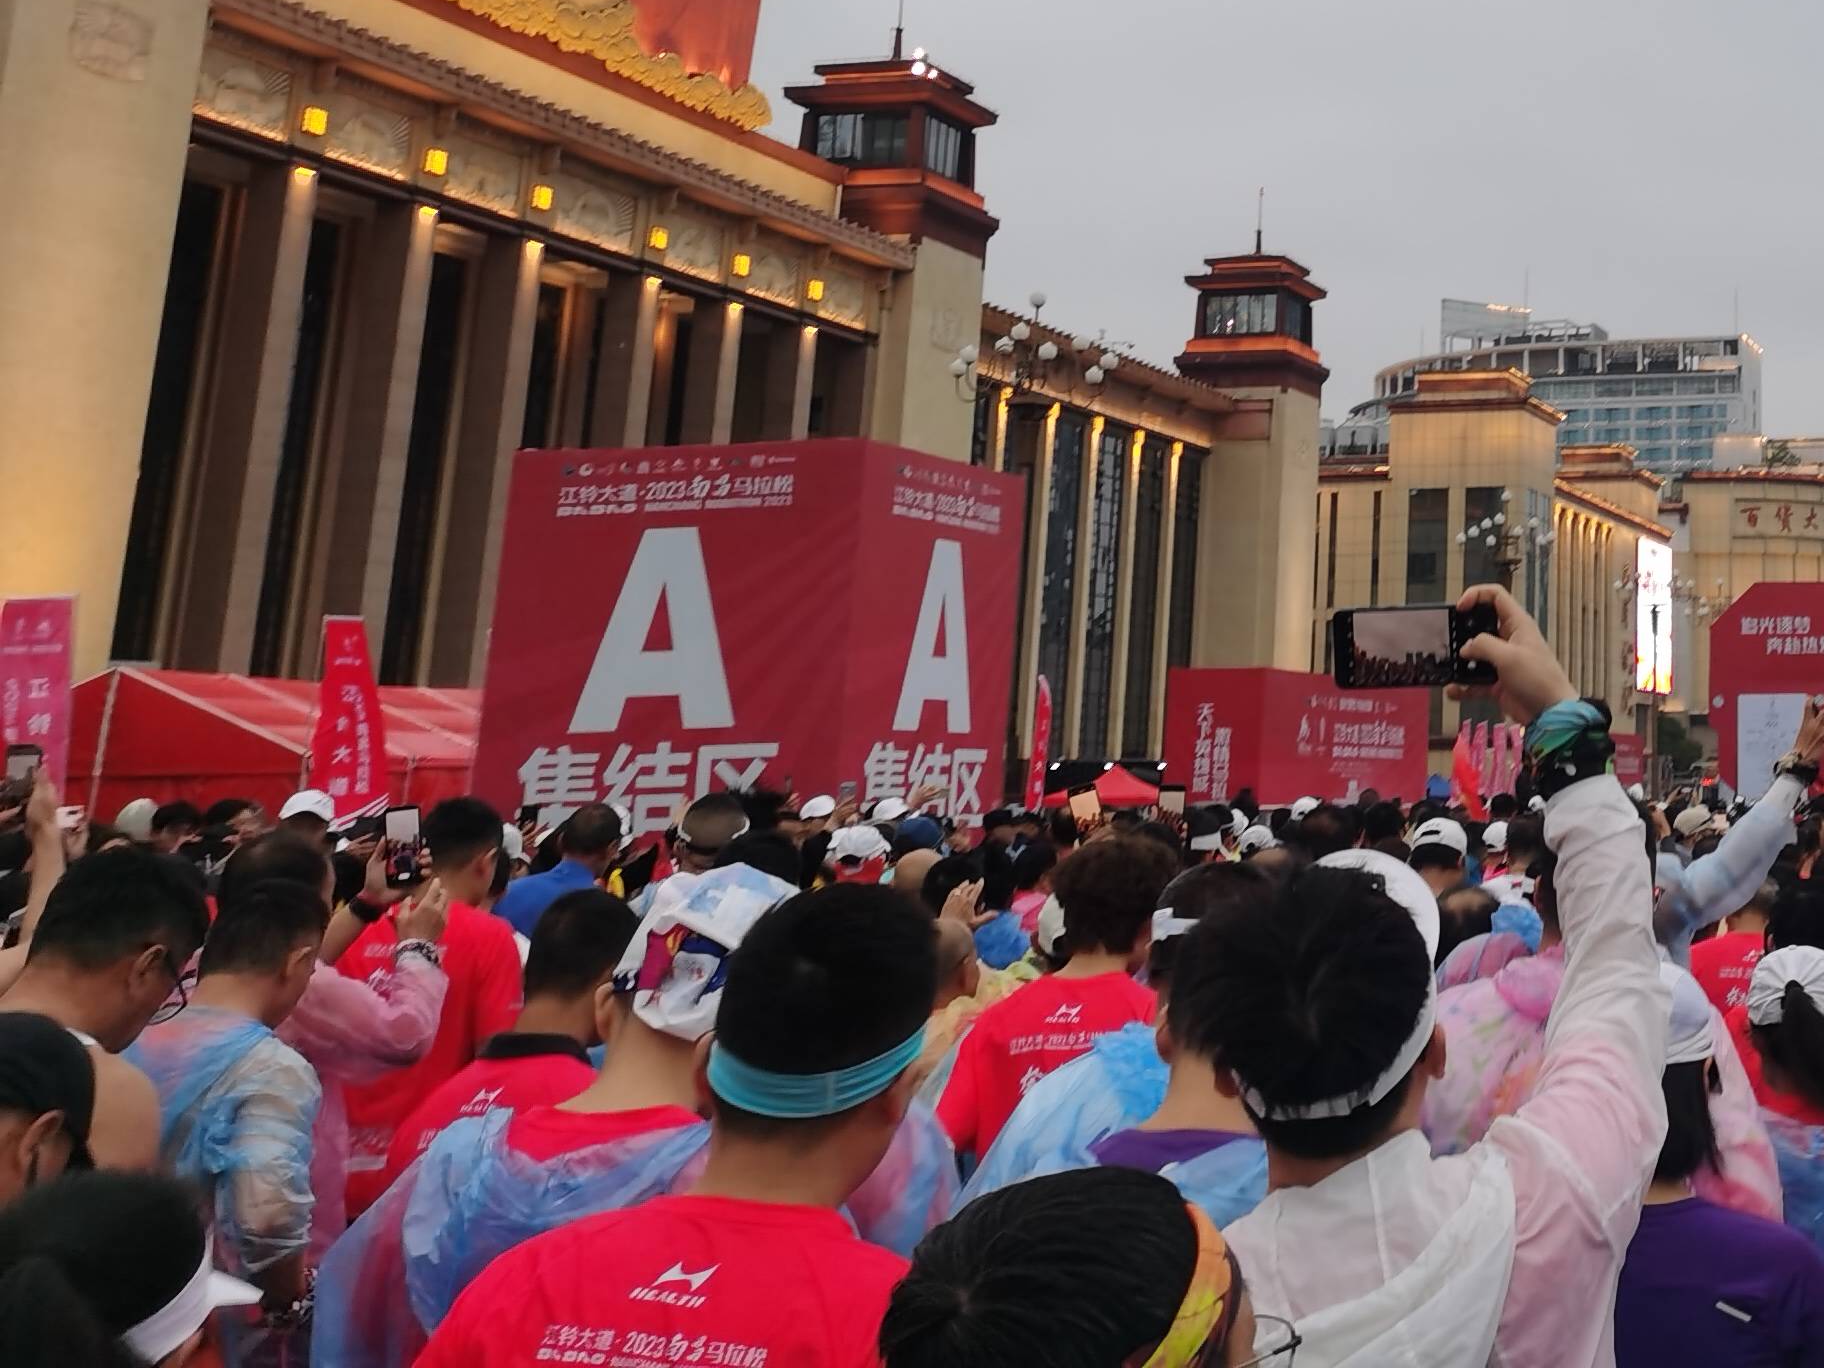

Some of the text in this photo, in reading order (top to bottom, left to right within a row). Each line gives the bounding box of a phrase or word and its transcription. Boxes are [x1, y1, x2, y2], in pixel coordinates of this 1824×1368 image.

[567, 526, 735, 734] A
[892, 538, 971, 734] A
[860, 740, 988, 828] 集结区
[628, 1286, 707, 1309] HEALTH
